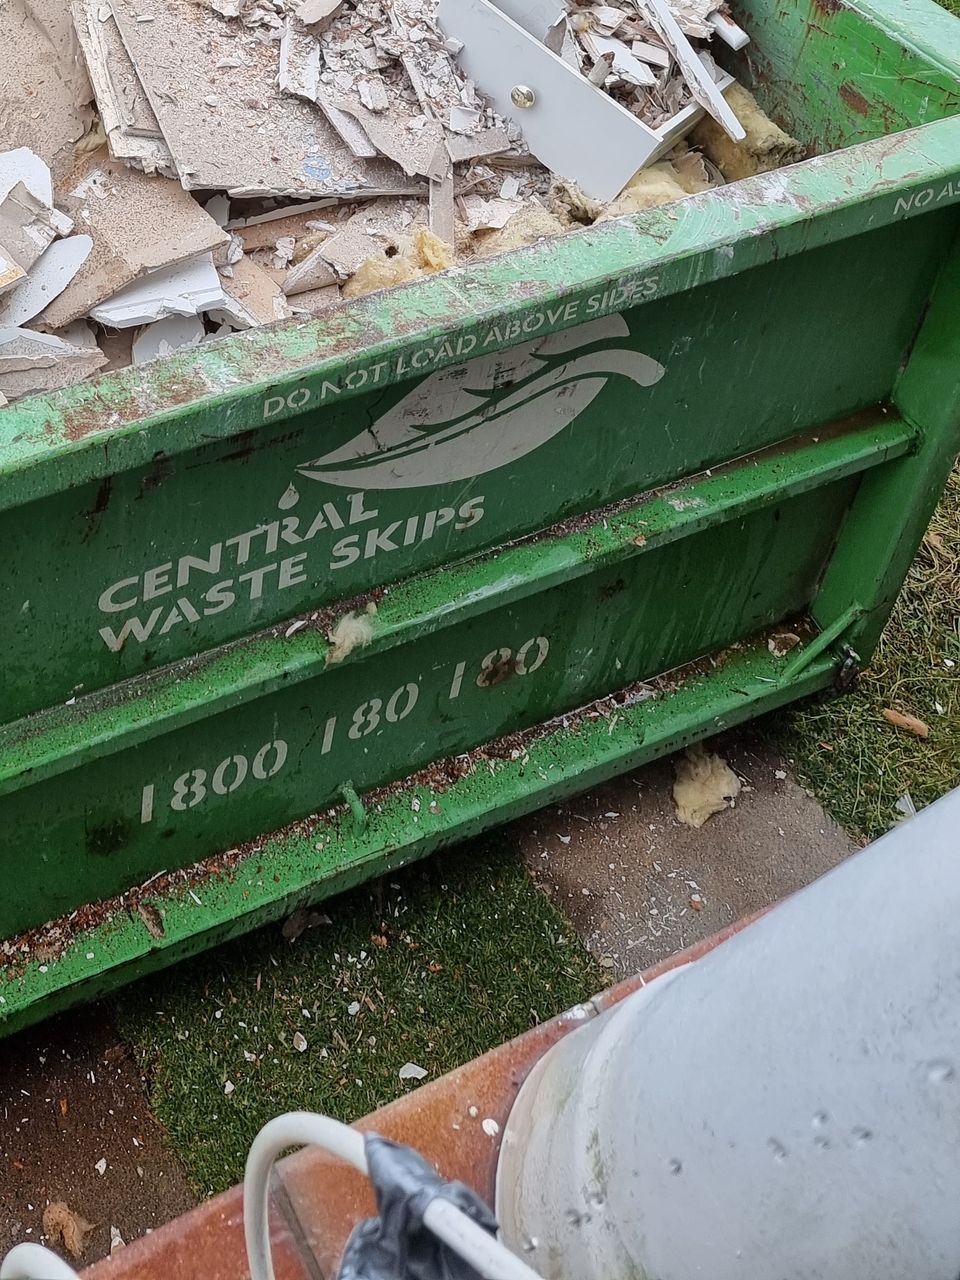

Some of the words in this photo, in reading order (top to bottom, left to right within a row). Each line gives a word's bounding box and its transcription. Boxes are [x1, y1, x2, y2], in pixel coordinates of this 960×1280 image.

[893, 189, 934, 215] NO
[263, 388, 311, 418] DO
[320, 365, 383, 399] NOT
[396, 334, 477, 373] LOAD
[483, 302, 578, 348] ABOVE
[585, 277, 659, 313] SIDES
[97, 491, 379, 614] CENTRAL
[98, 553, 308, 652] WASTE
[329, 495, 486, 569] SKIPS
[140, 739, 288, 824] 1800
[321, 682, 419, 755] 180
[448, 636, 550, 699] 180
